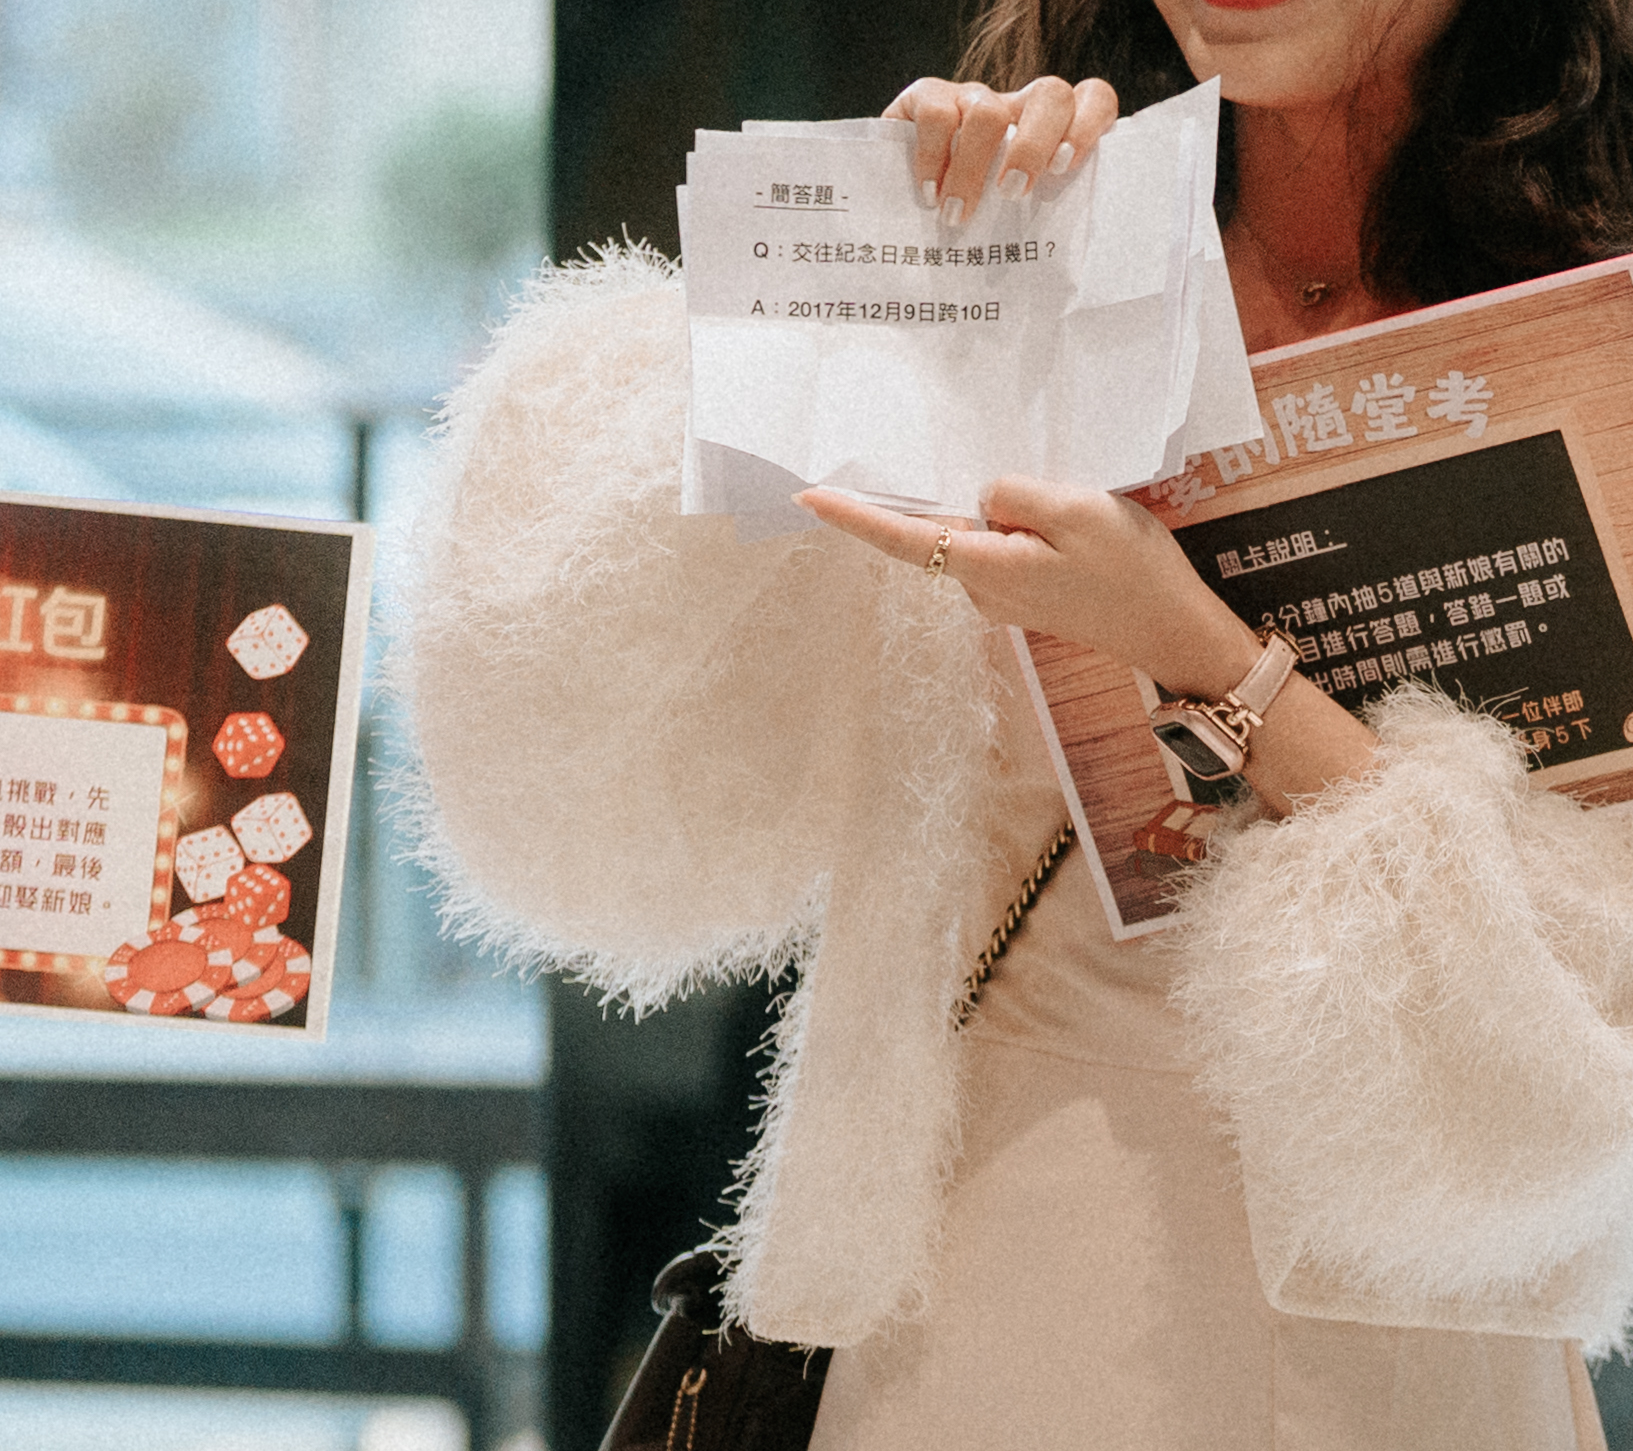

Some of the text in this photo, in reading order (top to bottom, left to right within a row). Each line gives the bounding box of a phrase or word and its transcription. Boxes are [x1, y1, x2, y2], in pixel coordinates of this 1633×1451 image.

[1295, 573, 1571, 664] 目進行答題，答錯一題或
